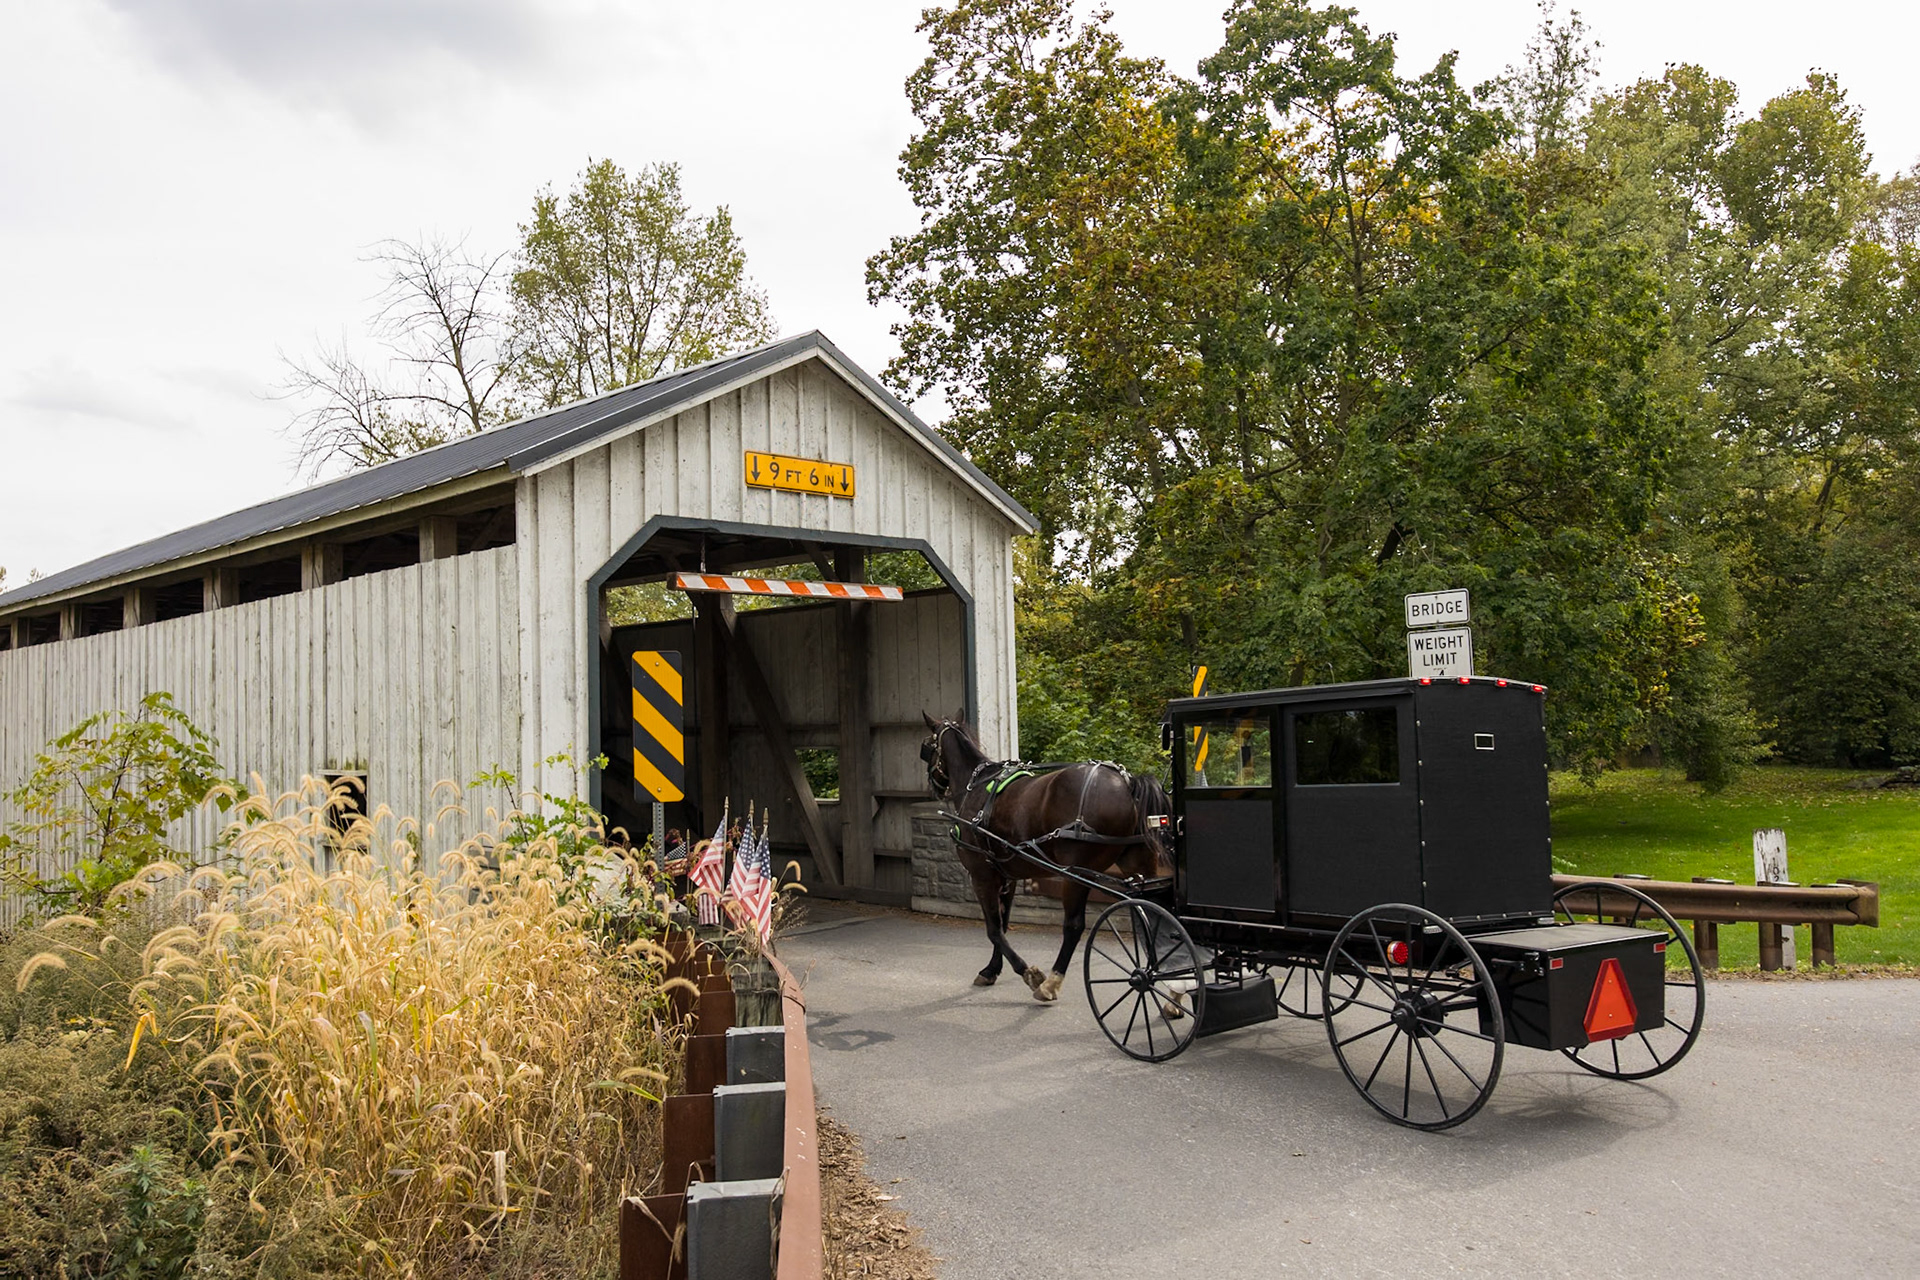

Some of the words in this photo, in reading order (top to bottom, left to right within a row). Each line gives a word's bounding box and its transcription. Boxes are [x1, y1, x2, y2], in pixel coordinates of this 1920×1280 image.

[769, 462, 780, 480] 9
[786, 470, 802, 483] FT
[809, 468, 819, 486] 6
[824, 475, 834, 488] IN
[1412, 600, 1463, 617] BRIDGE
[1414, 635, 1463, 651] WEIGHT
[1423, 652, 1457, 667] LIMIT
